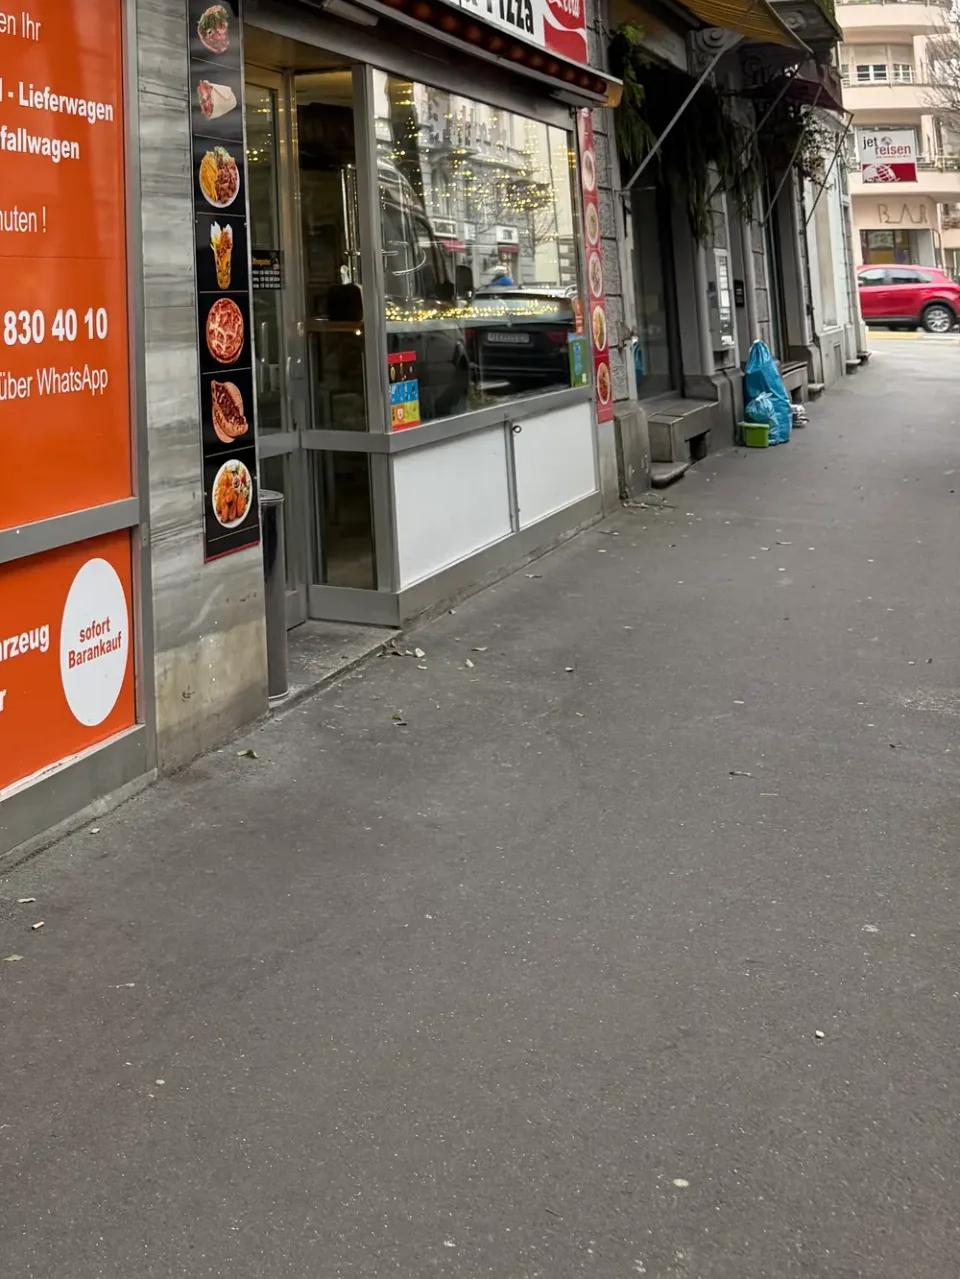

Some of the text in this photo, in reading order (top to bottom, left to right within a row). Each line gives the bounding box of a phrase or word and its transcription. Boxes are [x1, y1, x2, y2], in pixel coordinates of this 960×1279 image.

[21, 11, 41, 41] Ihr
[18, 81, 114, 124] Lieferwagen
[863, 136, 877, 150] jet
[875, 145, 911, 156] reisen
[878, 203, 928, 224] BAR
[3, 309, 45, 345] 830
[51, 308, 77, 342] 40
[83, 307, 108, 340] 10
[36, 363, 109, 396] WhatsApp
[79, 616, 111, 643] sofort
[67, 631, 122, 669] Barankauf
